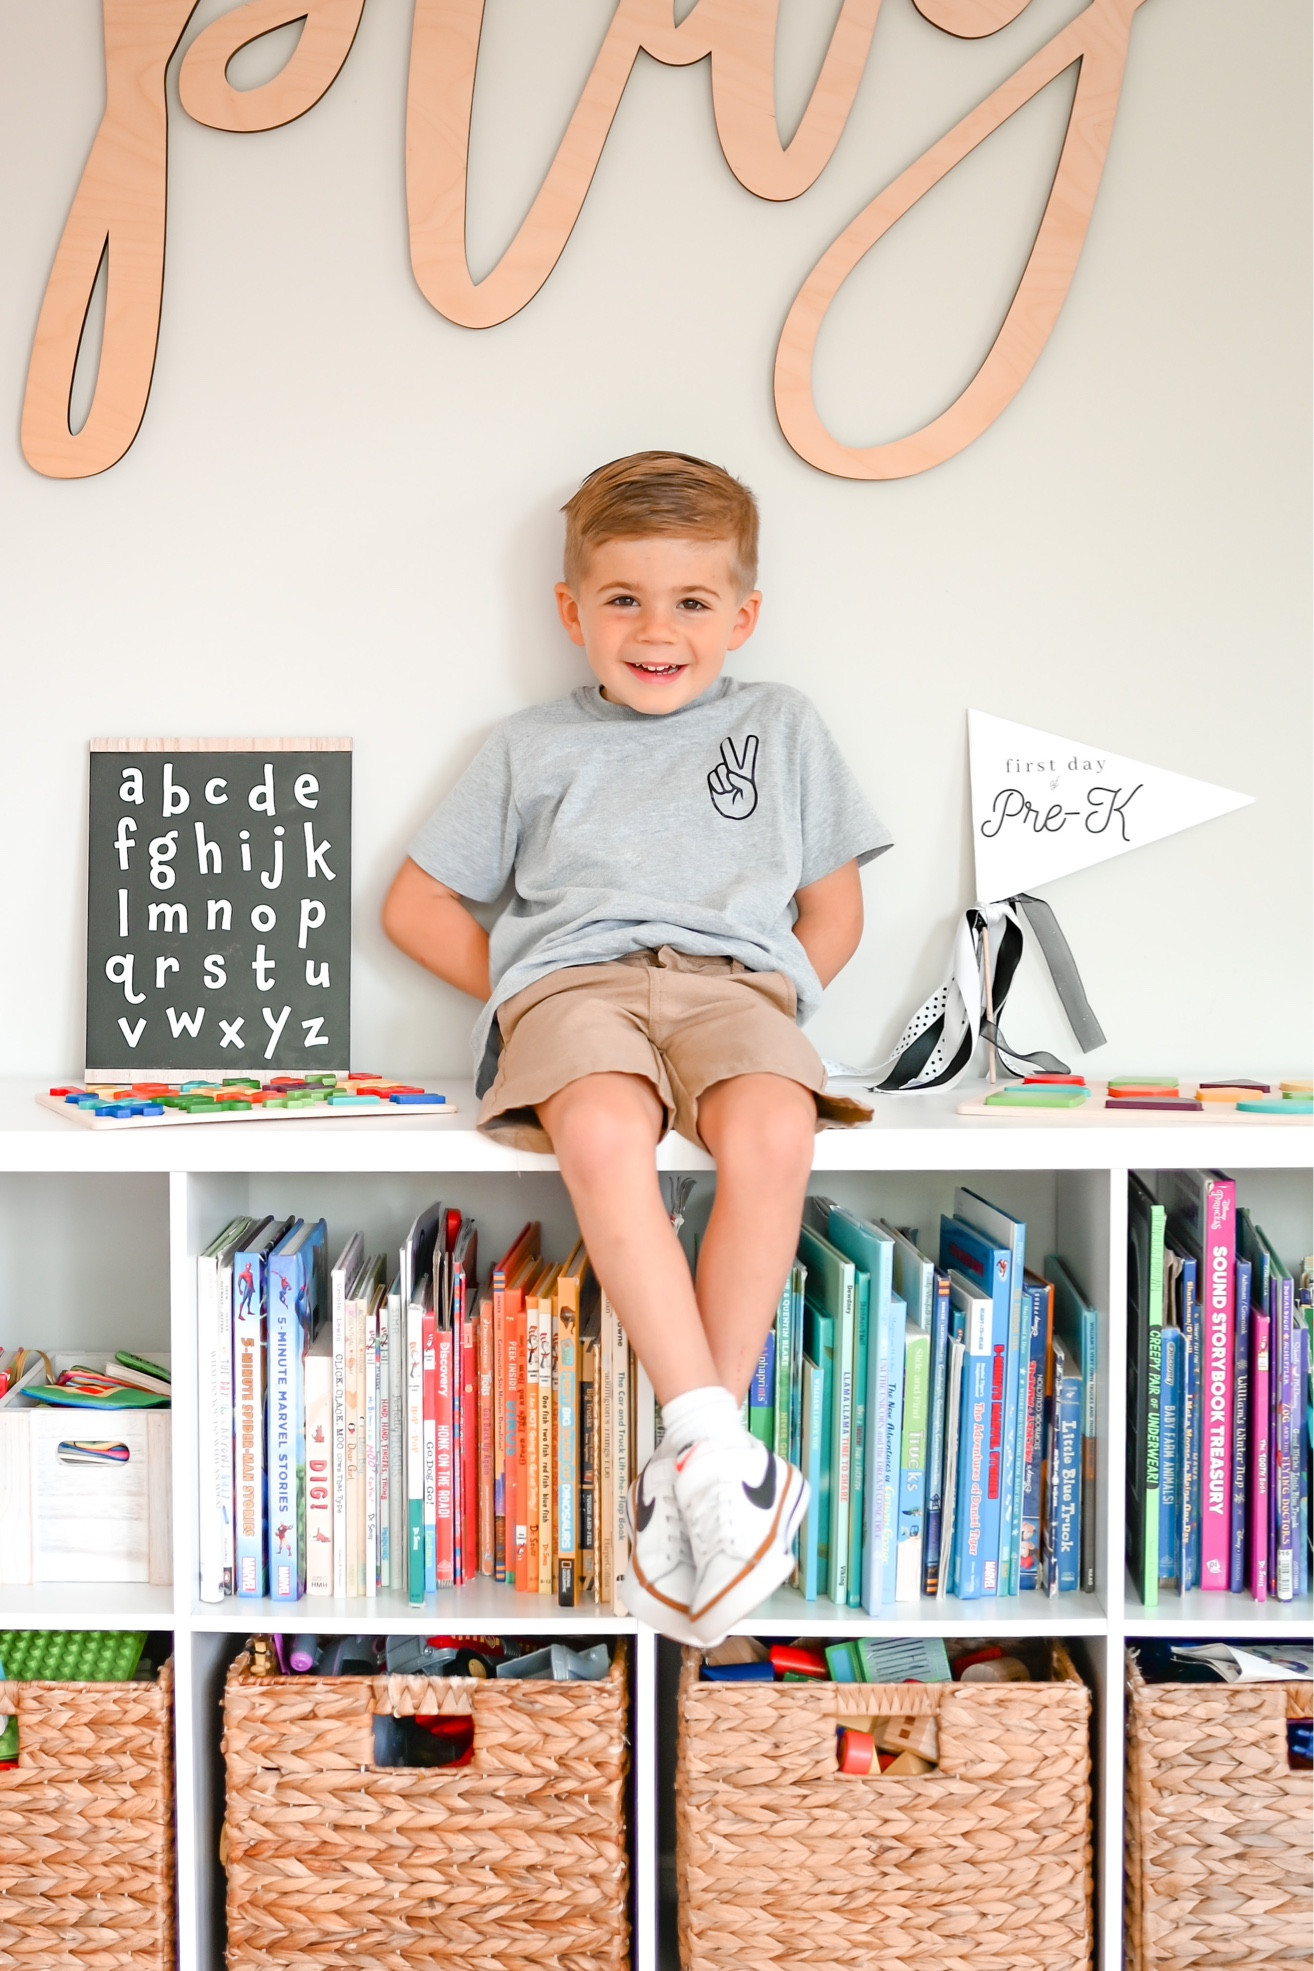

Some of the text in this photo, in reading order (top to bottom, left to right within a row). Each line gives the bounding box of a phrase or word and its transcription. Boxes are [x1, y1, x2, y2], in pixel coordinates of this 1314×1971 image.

[1005, 756, 1107, 773] first day
[119, 763, 320, 818] a b c d e
[980, 783, 1144, 842] Pre-K
[113, 816, 337, 890] f g h i j k
[118, 888, 326, 949] l m n o p
[105, 944, 331, 1005] q r s t u
[117, 1005, 329, 1060] v w x y z
[845, 1285, 854, 1315] Dewdney
[1240, 1274, 1249, 1300] Ashman
[507, 1341, 517, 1361] PEEK
[617, 1321, 625, 1347] rowne
[781, 1299, 791, 1367] QUENTIN BLAKE
[1148, 1329, 1161, 1370] CREEPY
[334, 1353, 345, 1388] CLICK,
[437, 1341, 451, 1397] Discovery
[507, 1363, 517, 1392] INSIDE
[755, 1349, 769, 1403] lphaprints
[1148, 1373, 1161, 1395] PAIR
[1165, 1341, 1176, 1387] Discovery
[1208, 1245, 1229, 1516] SOUND STORYBOOK TREASURY
[335, 1389, 345, 1425] CLACK,
[585, 1387, 594, 1401] Big
[887, 1383, 897, 1399] The
[974, 1402, 985, 1421] The
[1035, 1373, 1045, 1412] COLLECTION
[240, 1337, 255, 1537] 5-MINUTE SPIDER-MAN STORIES
[277, 1316, 289, 1513] 5-MINUTE MARVEL STORIES
[561, 1406, 573, 1427] BIG
[586, 1402, 595, 1428] Trucks
[840, 1371, 851, 1503] LLAMA LLAMA TIME TO SHARE
[905, 1347, 925, 1493] Slide and Find Trucks
[1234, 1375, 1249, 1489] William's Winter Nap
[336, 1428, 345, 1450] MOO
[346, 1443, 357, 1481] Dear Girl
[380, 1398, 389, 1501] HAND, HAND, FINGERS, THUMB
[541, 1395, 550, 1523] One fish two fish red fish blue fish
[616, 1371, 626, 1541] The Car and Truck Lift-the-Flap Book
[971, 1423, 984, 1481] Adventures
[1146, 1412, 1160, 1485] UNDERWEAR!
[1161, 1405, 1177, 1505] BABY FARM ANIMALS!
[309, 1459, 329, 1510] DIG!
[438, 1424, 451, 1519] HONK ON THE ROAD!
[483, 1454, 492, 1476] Again
[1060, 1420, 1078, 1553] Little Blue Truck
[1258, 1439, 1268, 1495] The TOOTH Book
[1281, 1402, 1291, 1545] ZOG FLYING DOCTORS
[335, 1494, 344, 1514] Type
[425, 1486, 435, 1506] Go!
[969, 1497, 982, 1528] Daniel
[971, 1483, 983, 1496] of
[561, 1483, 573, 1550] DINOSAURS
[968, 1529, 981, 1556] Tiger
[242, 1557, 257, 1592] MARVEL
[277, 1565, 291, 1597] MARVEL
[838, 1565, 847, 1587] Viking
